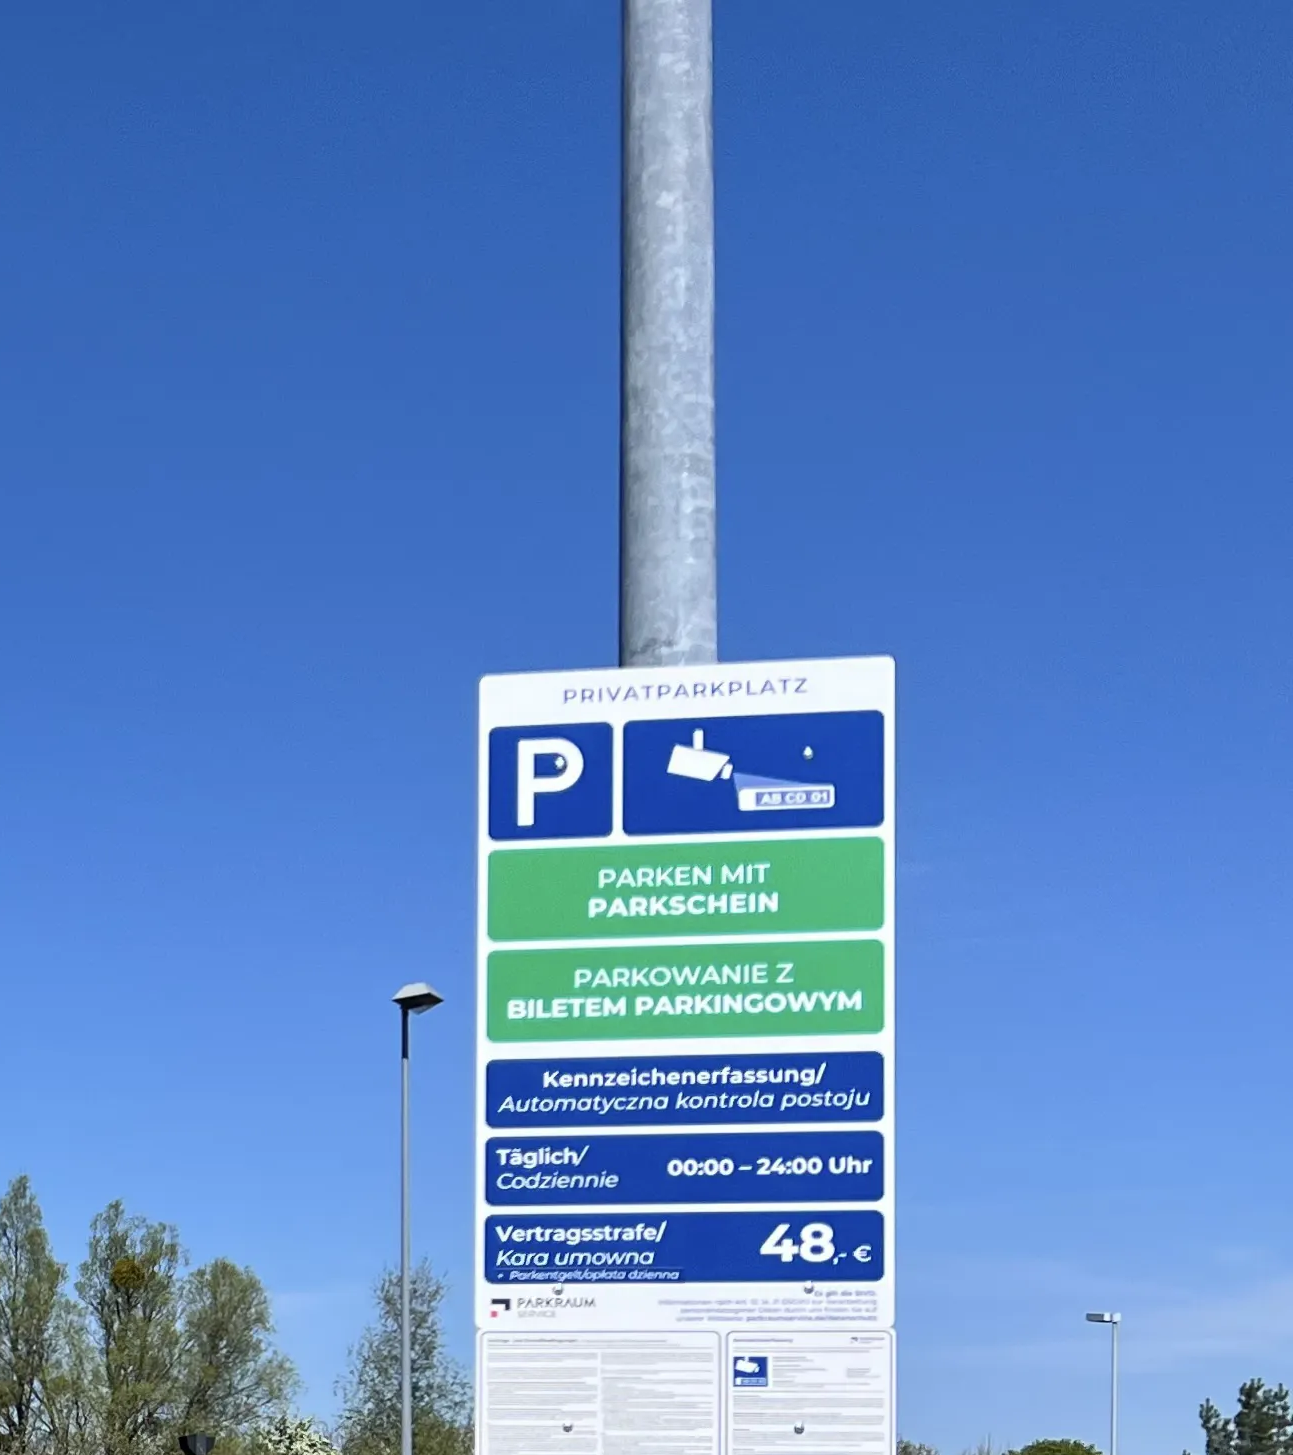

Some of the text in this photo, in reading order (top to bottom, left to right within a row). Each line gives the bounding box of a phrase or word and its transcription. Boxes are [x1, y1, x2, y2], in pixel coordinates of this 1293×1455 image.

[562, 677, 809, 705] PRIVATPARKPLATZ
[516, 736, 584, 827] P
[760, 793, 782, 805] AB
[784, 791, 807, 804] CD
[597, 862, 771, 889] PARKEN MIT
[587, 891, 779, 918] PARKSCHEIN
[573, 961, 795, 989] PARKOWANIE Z
[506, 989, 863, 1020] BILETEM PARKINGOWYM
[541, 1061, 828, 1089] Kennzeichenerfassung/
[496, 1087, 872, 1115] Automatyczna kontrola postoju
[495, 1144, 591, 1169] Täglich/
[666, 1157, 735, 1177] 00:00
[755, 1156, 824, 1176] 24:00
[828, 1154, 873, 1175] Uhr
[496, 1169, 620, 1190] Codziennie
[494, 1220, 668, 1246] Vertragsstrafe/
[852, 1244, 872, 1262] €
[495, 1249, 655, 1267] Kara umowna
[627, 1269, 680, 1281] dzienna
[516, 1297, 597, 1309] PARKRAUM
